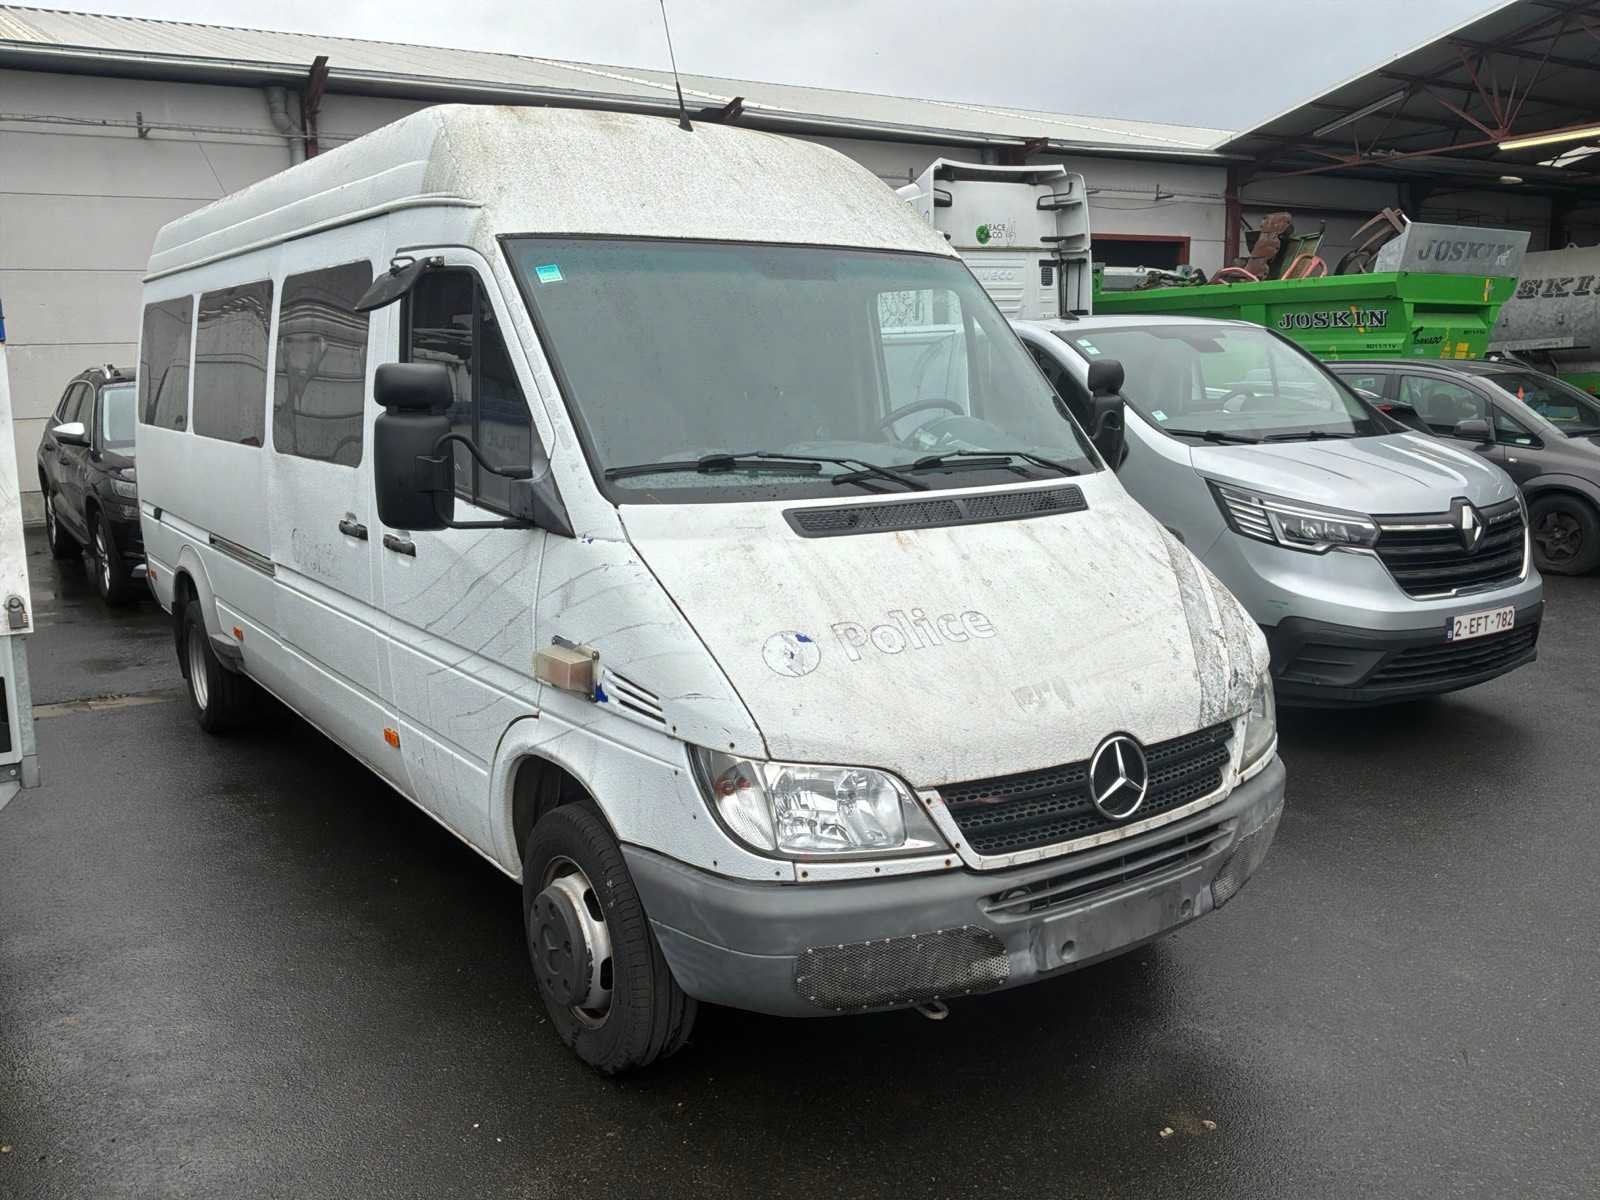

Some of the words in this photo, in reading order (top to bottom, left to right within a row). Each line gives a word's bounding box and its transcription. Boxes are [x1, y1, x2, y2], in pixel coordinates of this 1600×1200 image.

[1417, 239, 1514, 262] JOSKIN
[1516, 274, 1600, 300] SKI
[1278, 309, 1387, 330] JOSKIN
[830, 607, 998, 662] Police
[1454, 611, 1514, 637] 2-EFT-782
